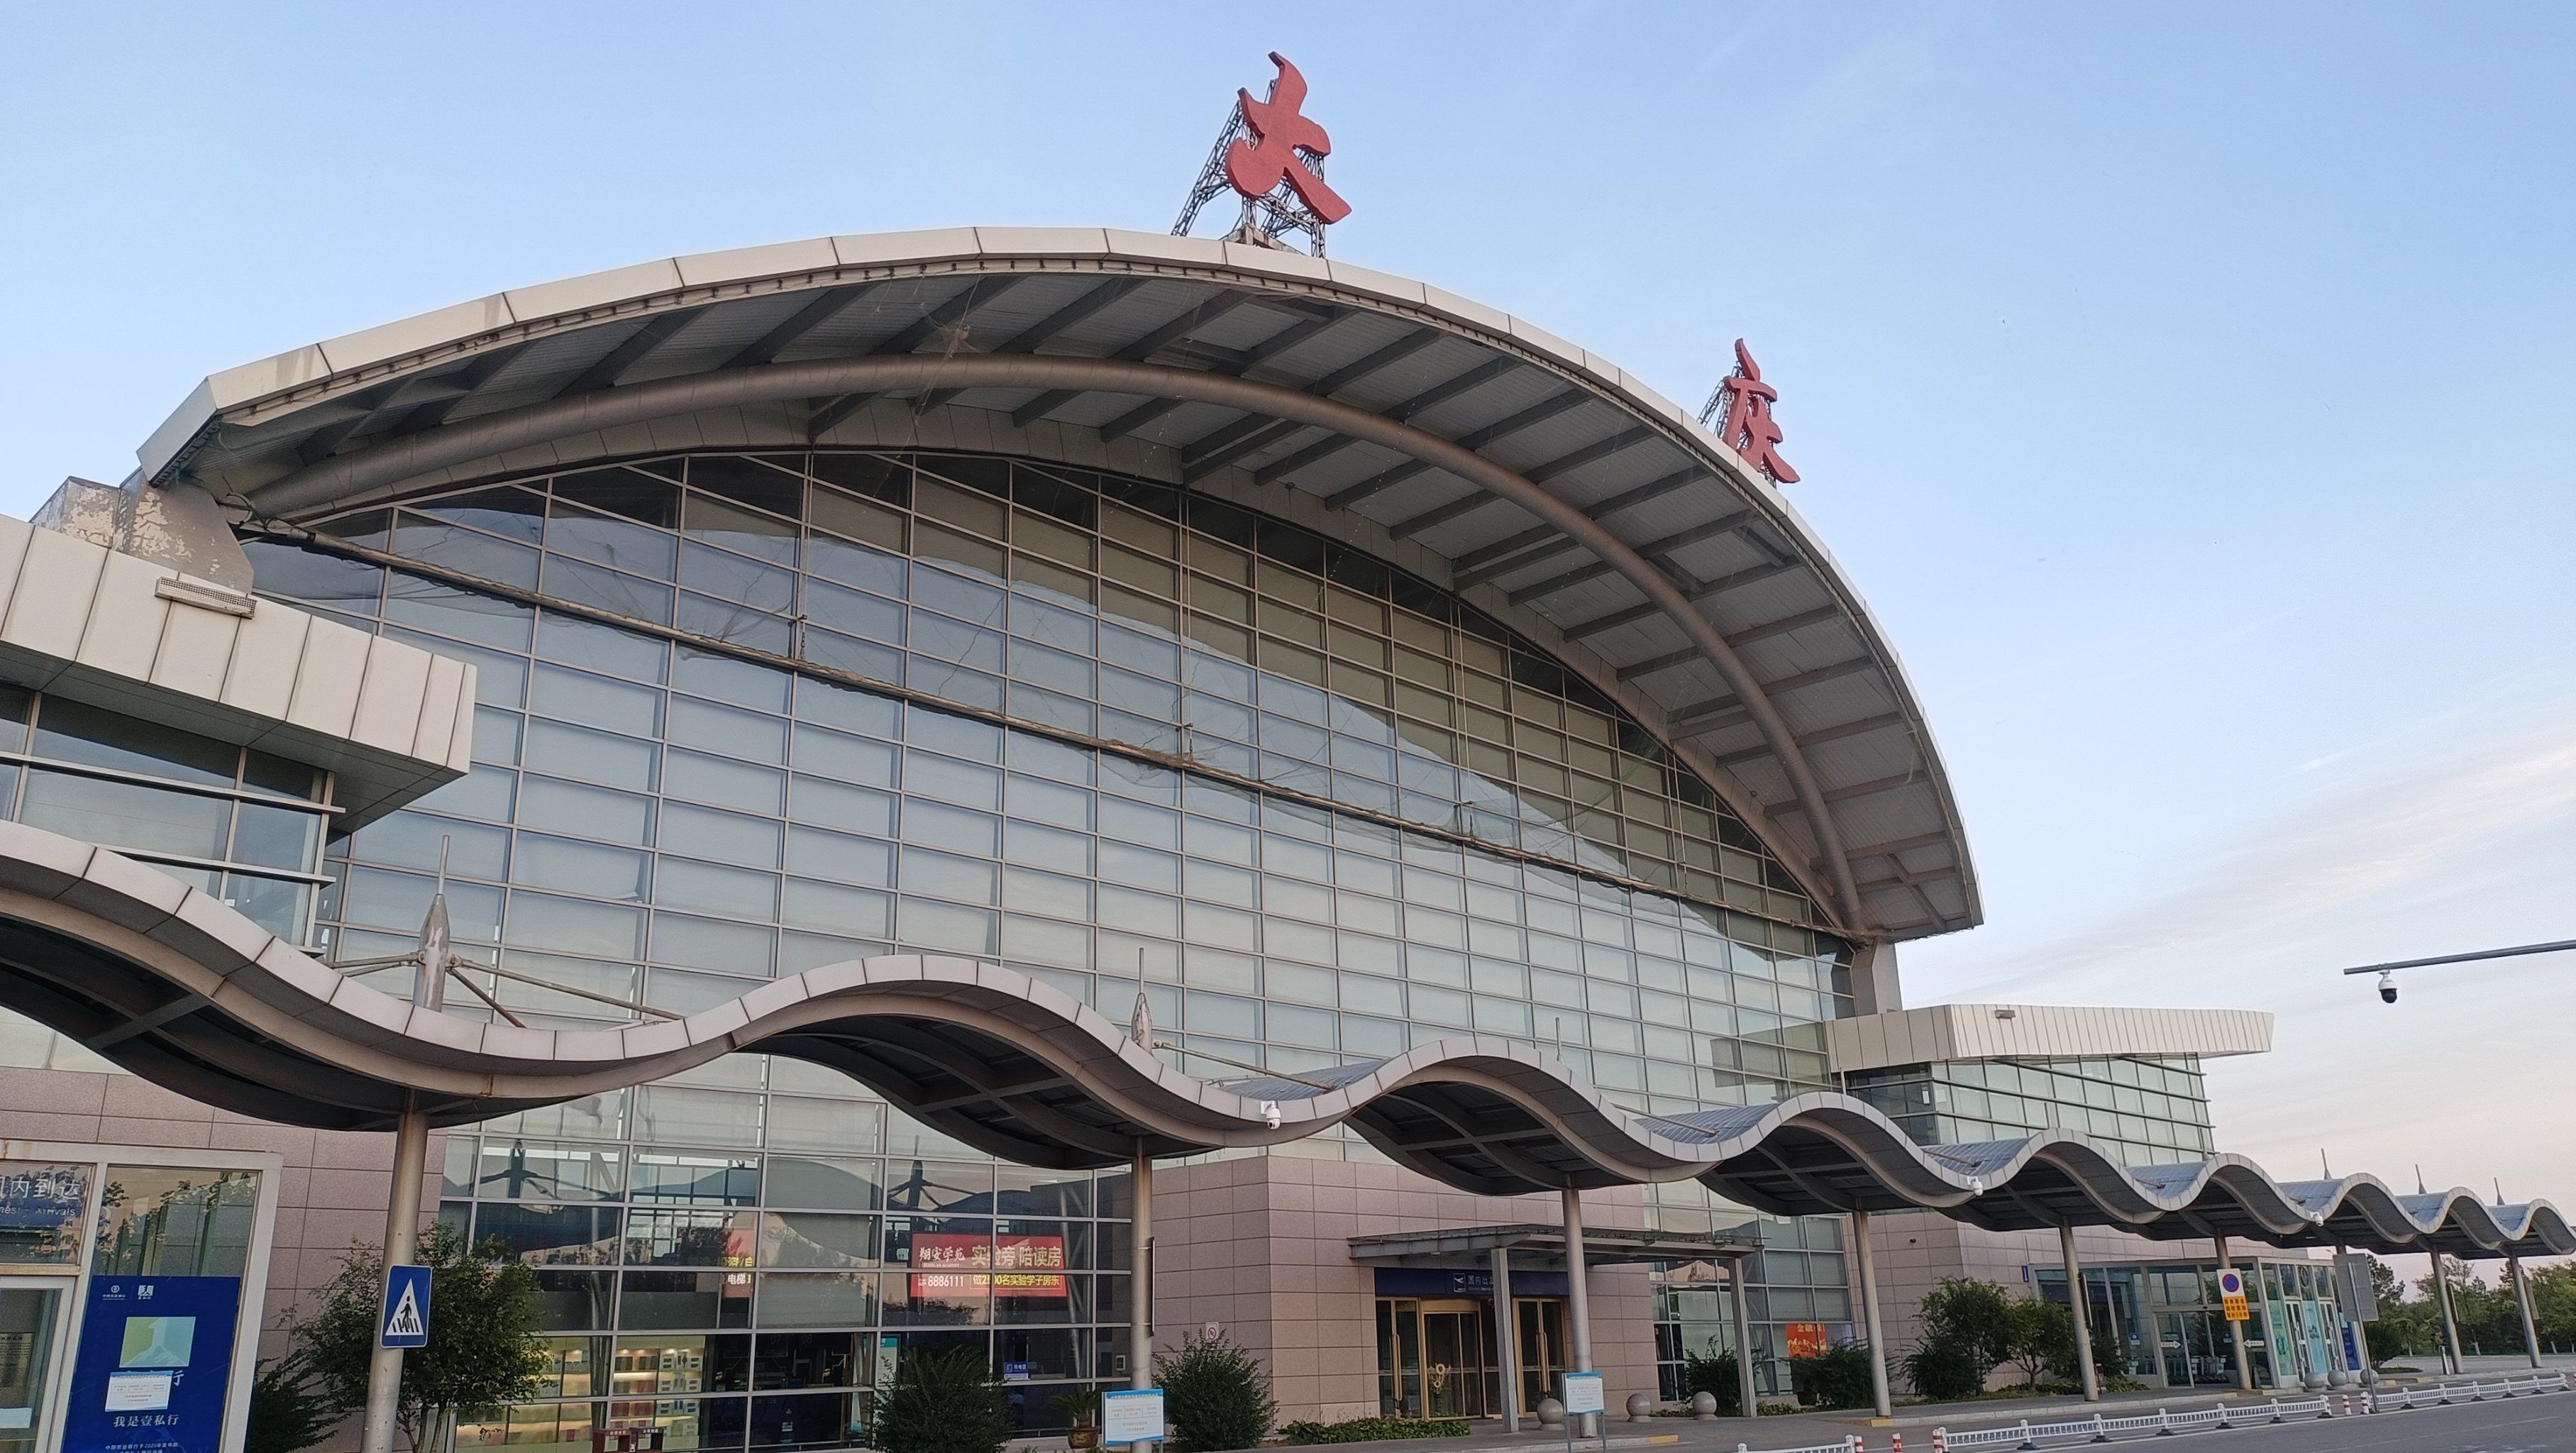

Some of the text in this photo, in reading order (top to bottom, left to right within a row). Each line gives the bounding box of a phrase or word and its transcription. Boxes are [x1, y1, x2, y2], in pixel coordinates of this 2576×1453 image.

[1225, 51, 1801, 483] 大 庆
[0, 1177, 81, 1200] 内到达
[35, 1208, 76, 1216] Arrivals
[1019, 1246, 1061, 1267] 陪读房
[928, 1276, 964, 1287] 8886111
[114, 1414, 179, 1427] 我是壹私行
